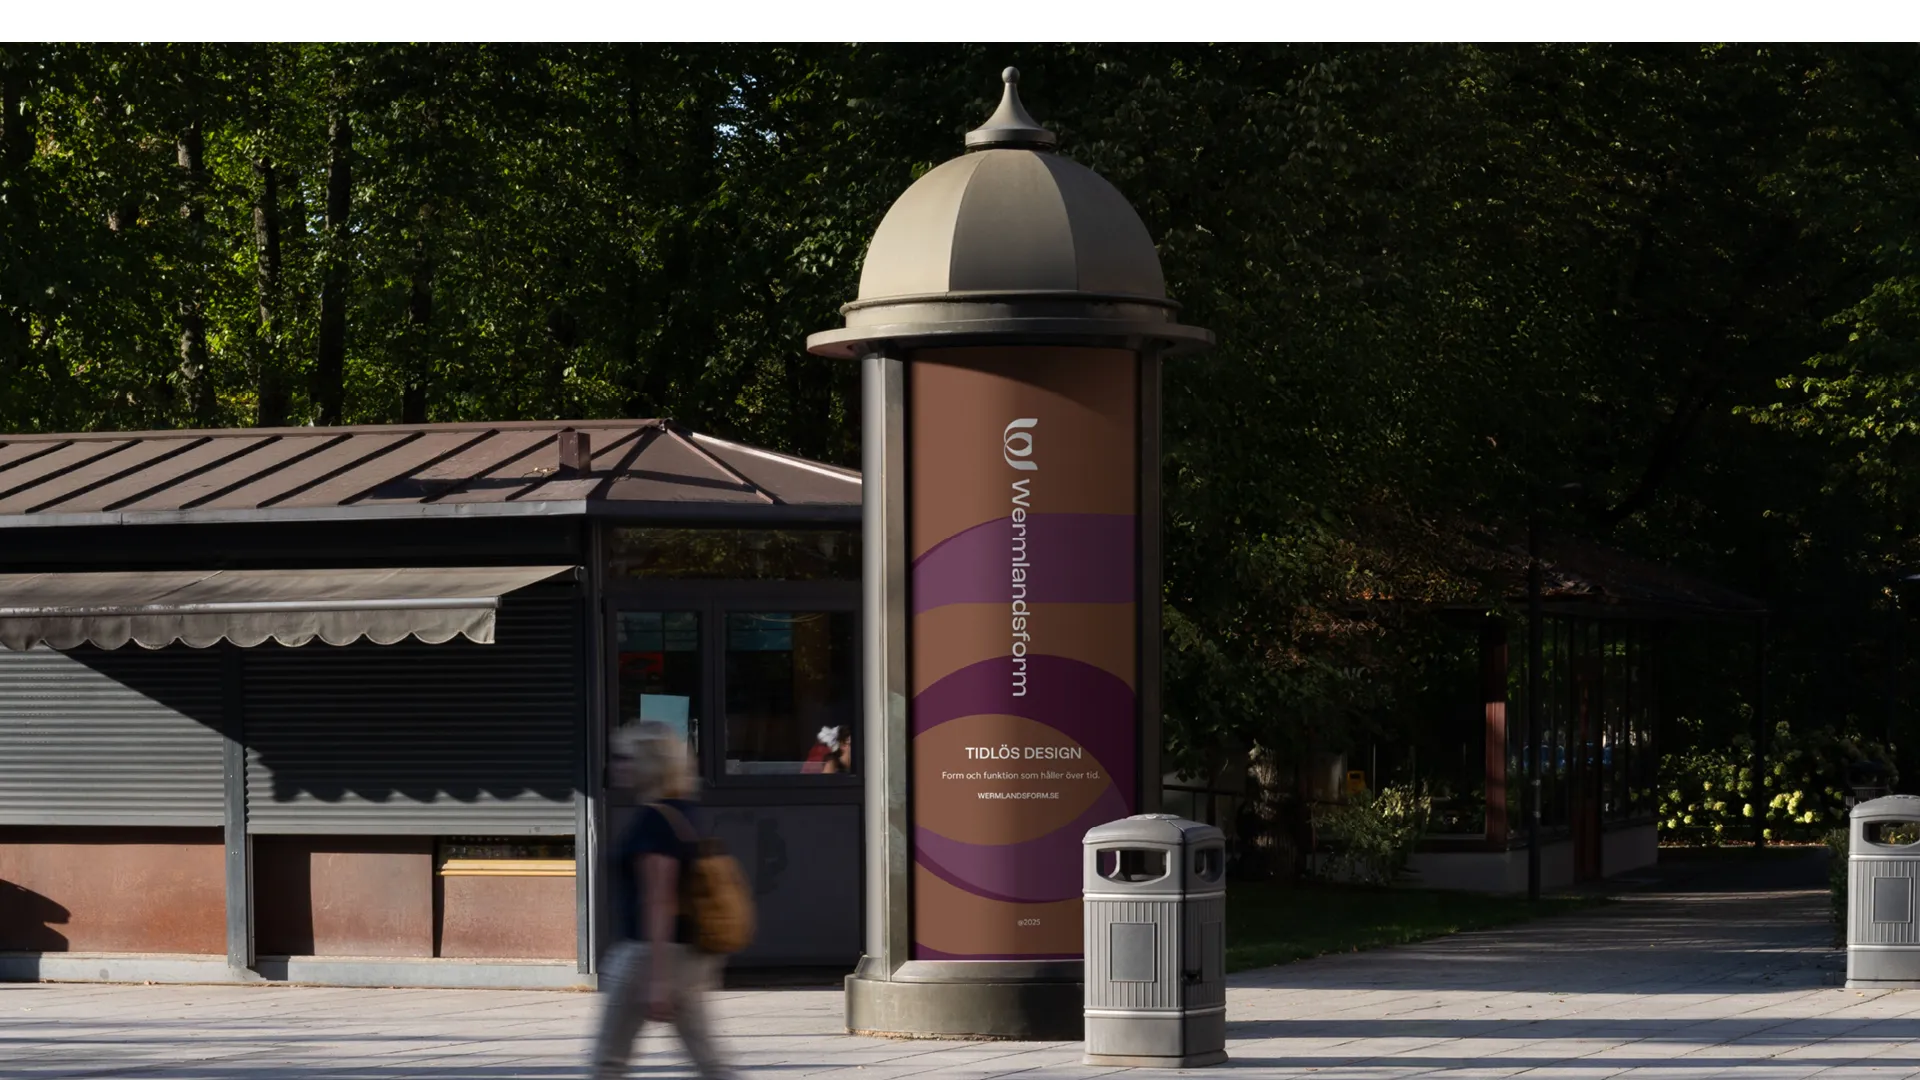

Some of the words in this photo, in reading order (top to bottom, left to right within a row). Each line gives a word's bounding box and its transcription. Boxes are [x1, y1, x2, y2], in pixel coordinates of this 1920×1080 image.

[1011, 478, 1031, 697] Wermlandsform
[965, 744, 1020, 760] TIDLÖS
[1024, 747, 1082, 760] DESIGN
[941, 771, 964, 780] Form
[967, 771, 982, 780] och
[983, 771, 1019, 780] funktion
[1040, 770, 1064, 780] håller
[1066, 770, 1084, 780] över
[1086, 770, 1101, 780] tid.
[977, 792, 1060, 800] WERMLANDSFORM.SE
